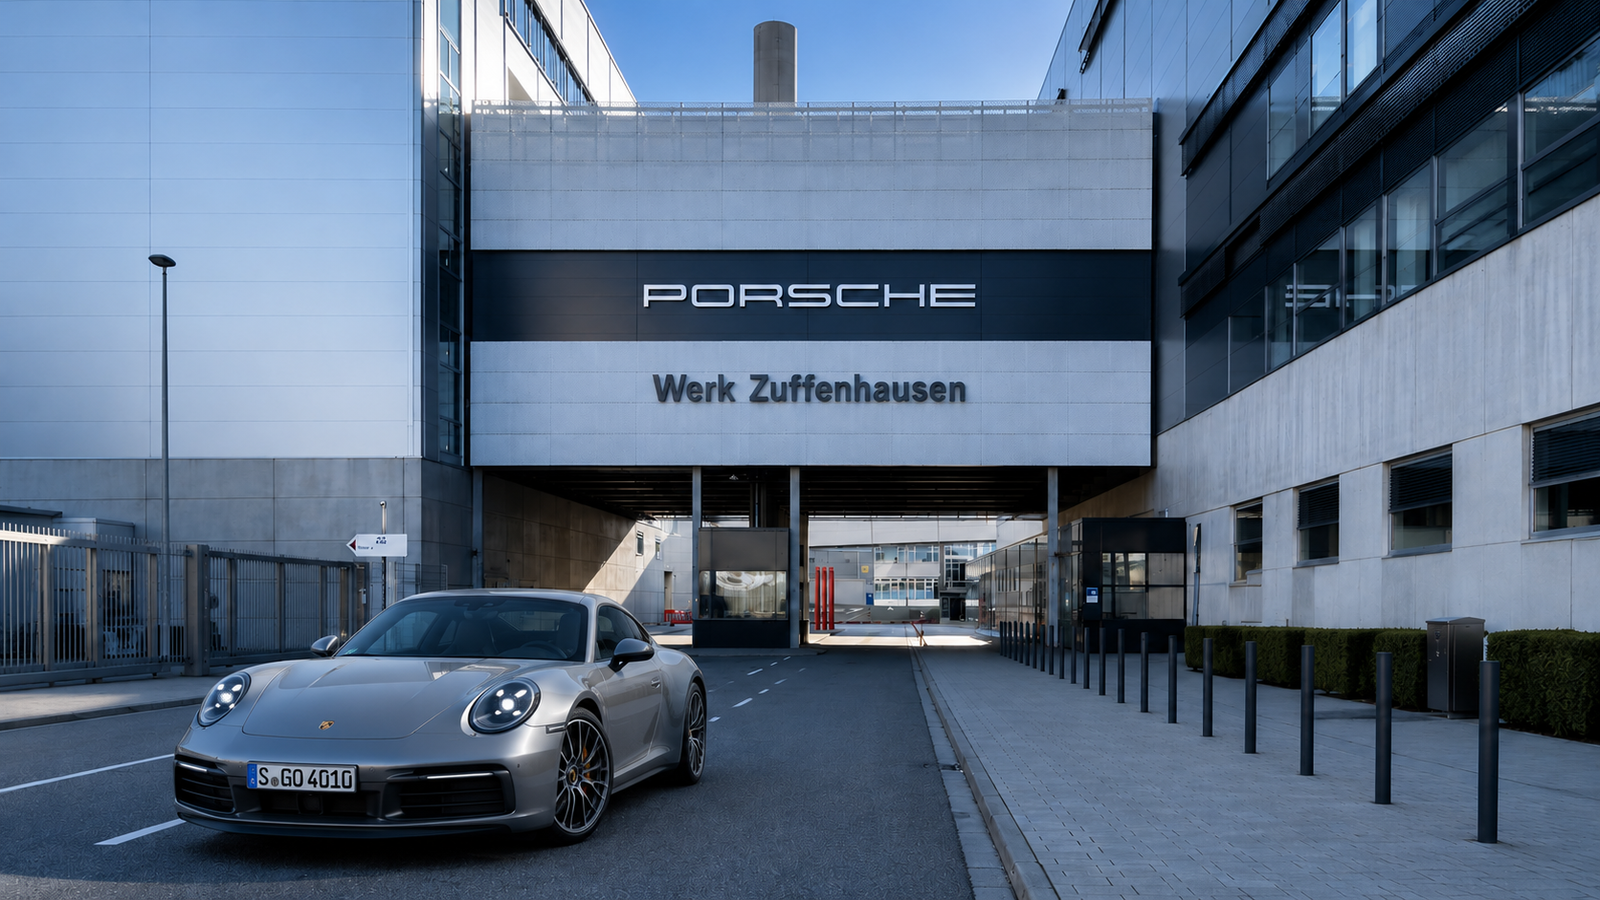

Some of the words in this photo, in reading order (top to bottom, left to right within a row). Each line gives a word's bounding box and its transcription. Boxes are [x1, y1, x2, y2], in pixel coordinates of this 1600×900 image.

[643, 284, 976, 308] PORSCHE
[652, 374, 736, 403] Werk
[749, 374, 967, 403] Zuffenhausen
[258, 767, 269, 786] S
[281, 768, 304, 787] GO
[307, 769, 353, 789] 4010
